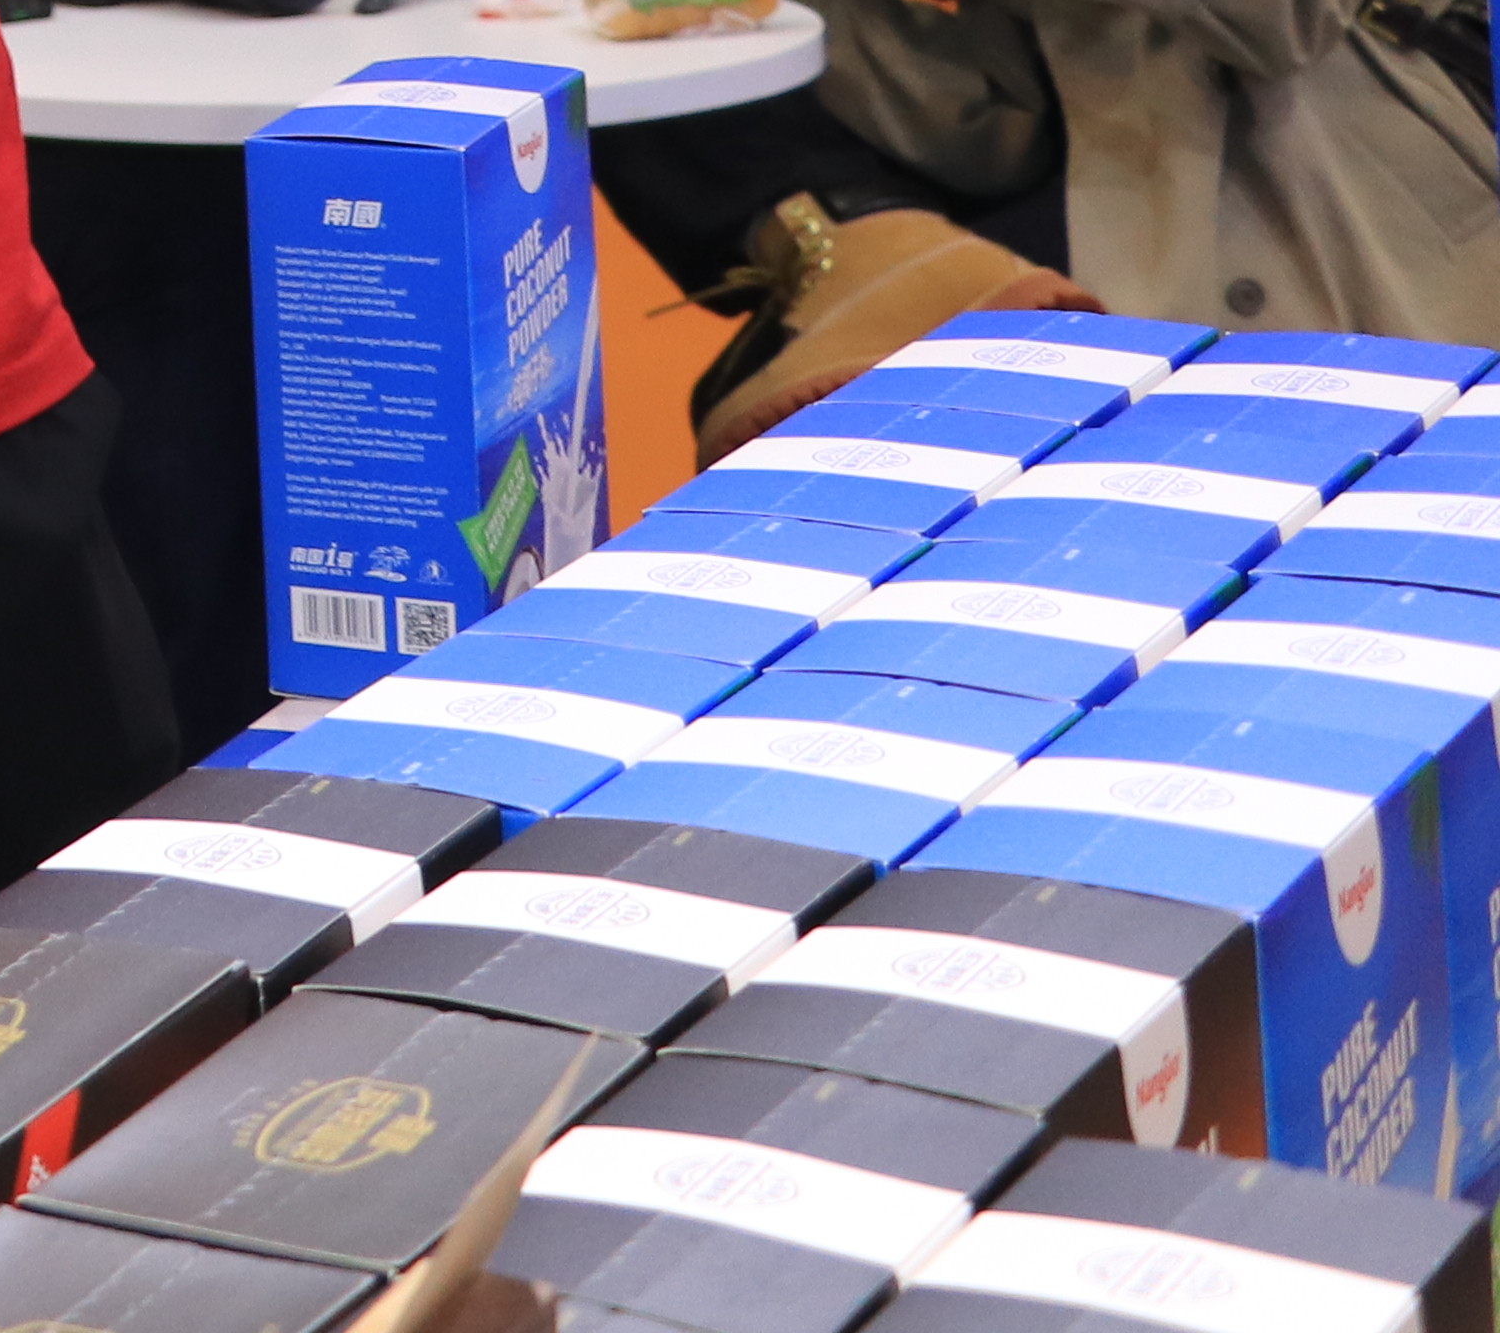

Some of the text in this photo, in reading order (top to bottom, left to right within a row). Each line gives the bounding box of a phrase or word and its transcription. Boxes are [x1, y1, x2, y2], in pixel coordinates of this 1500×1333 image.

[503, 218, 543, 289] PURE
[506, 225, 572, 329] COCONUT
[508, 272, 569, 369] POWDER
[1321, 999, 1378, 1127] PURE
[1325, 997, 1419, 1178] COCONUT
